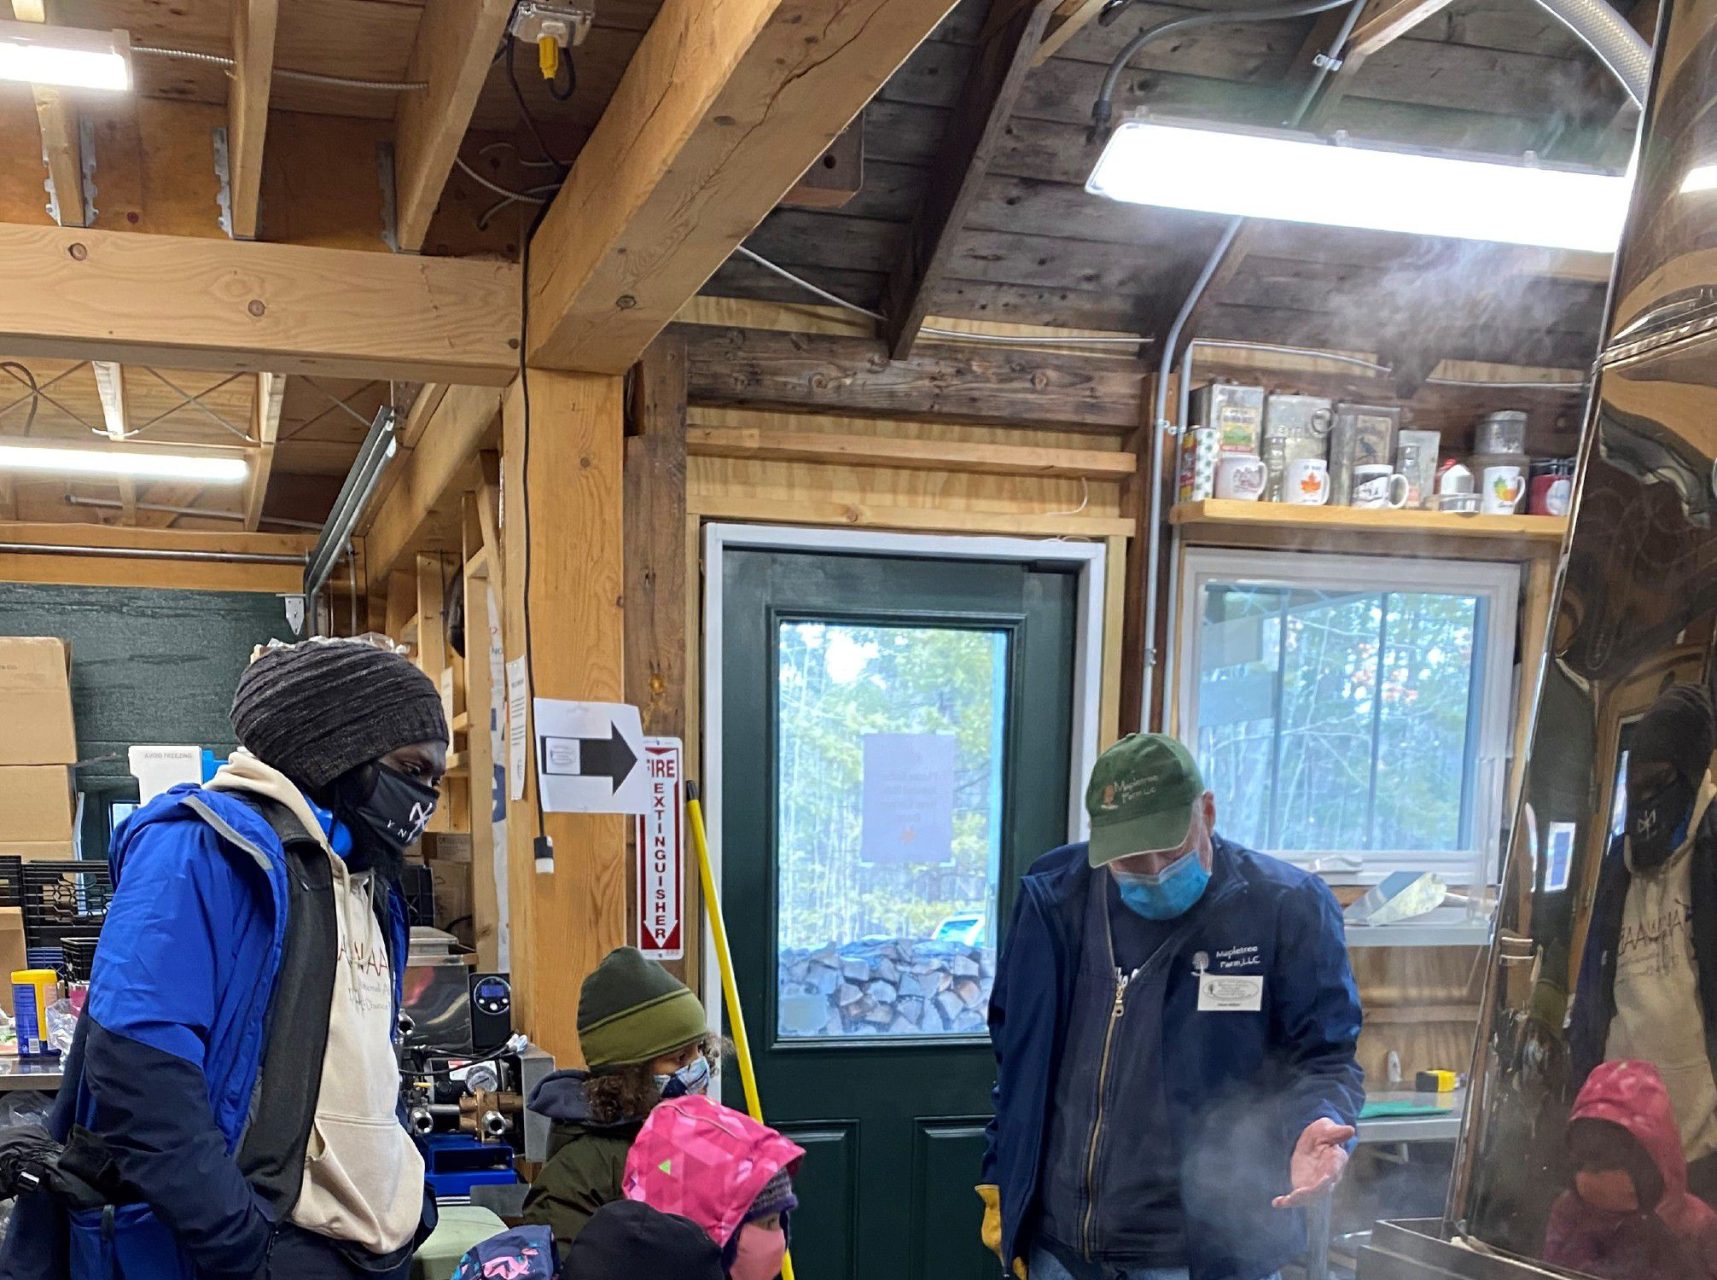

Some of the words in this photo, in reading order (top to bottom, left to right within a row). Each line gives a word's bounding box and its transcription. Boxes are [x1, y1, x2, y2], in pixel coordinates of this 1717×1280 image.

[646, 759, 676, 779] IRE
[653, 782, 667, 940] EXTINGUISHER
[1216, 945, 1258, 960] Mapletree
